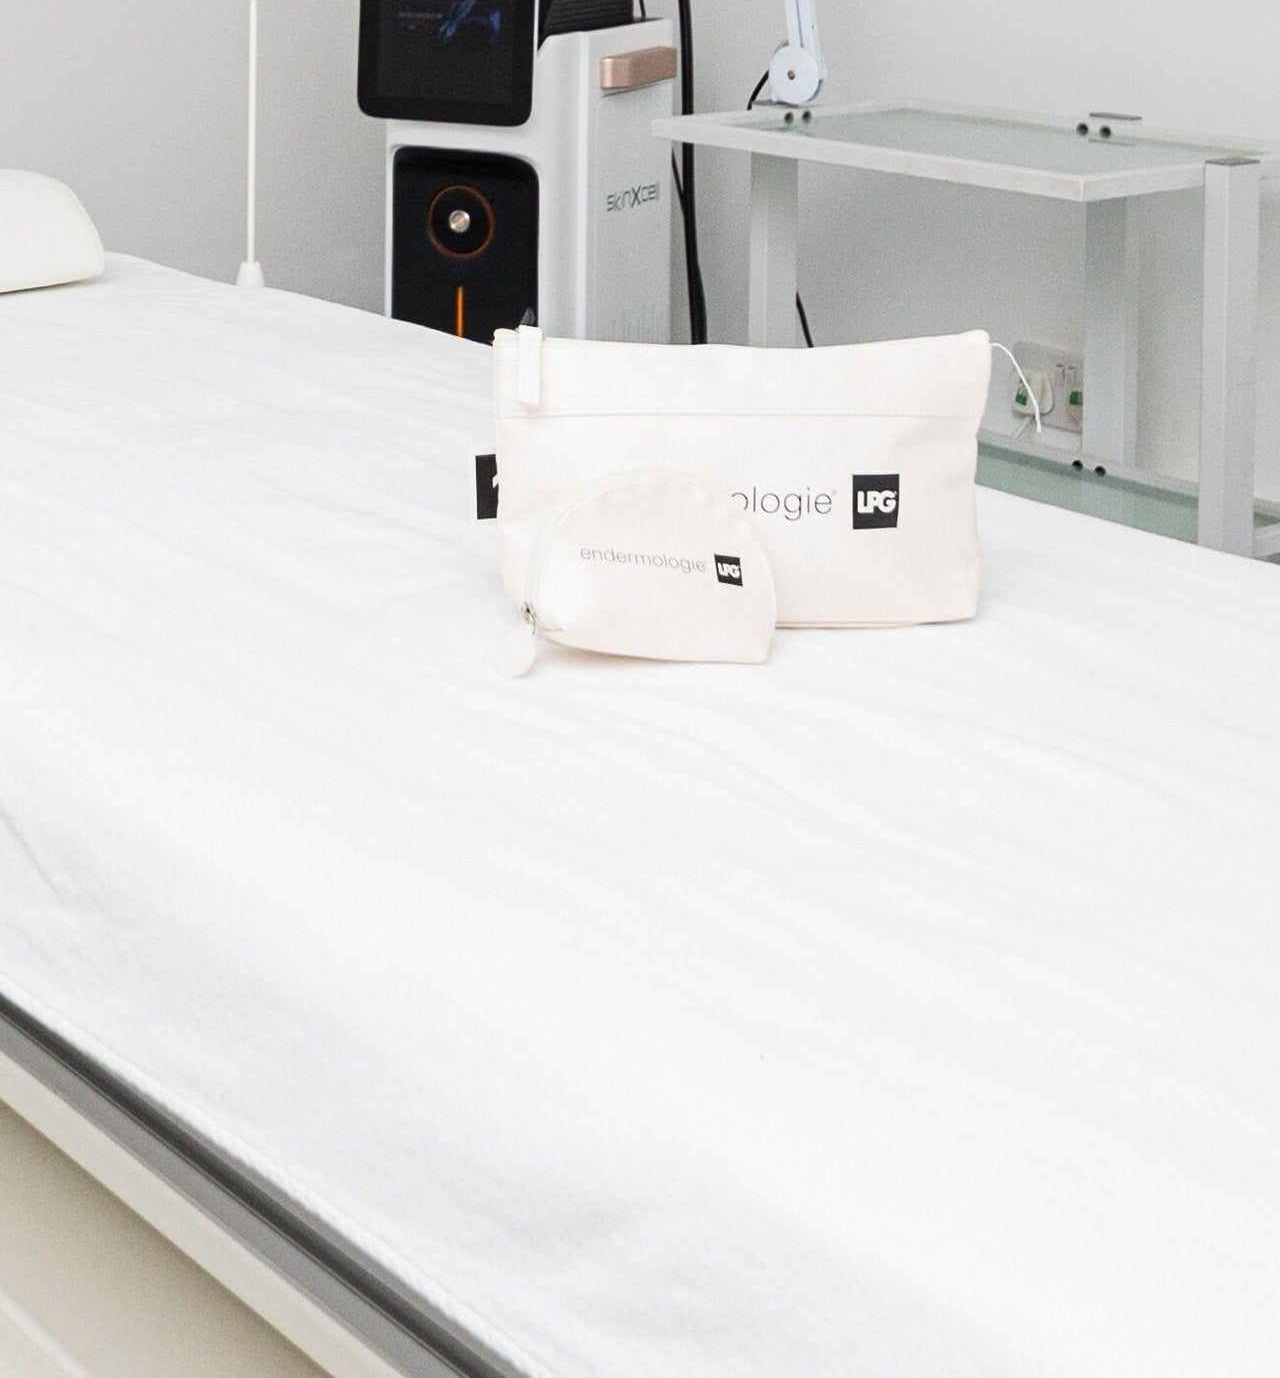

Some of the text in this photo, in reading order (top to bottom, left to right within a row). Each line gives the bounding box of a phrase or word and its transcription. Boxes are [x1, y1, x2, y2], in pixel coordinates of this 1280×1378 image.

[731, 485, 898, 521] ologie LPG
[580, 547, 741, 579] endermologie LPG
